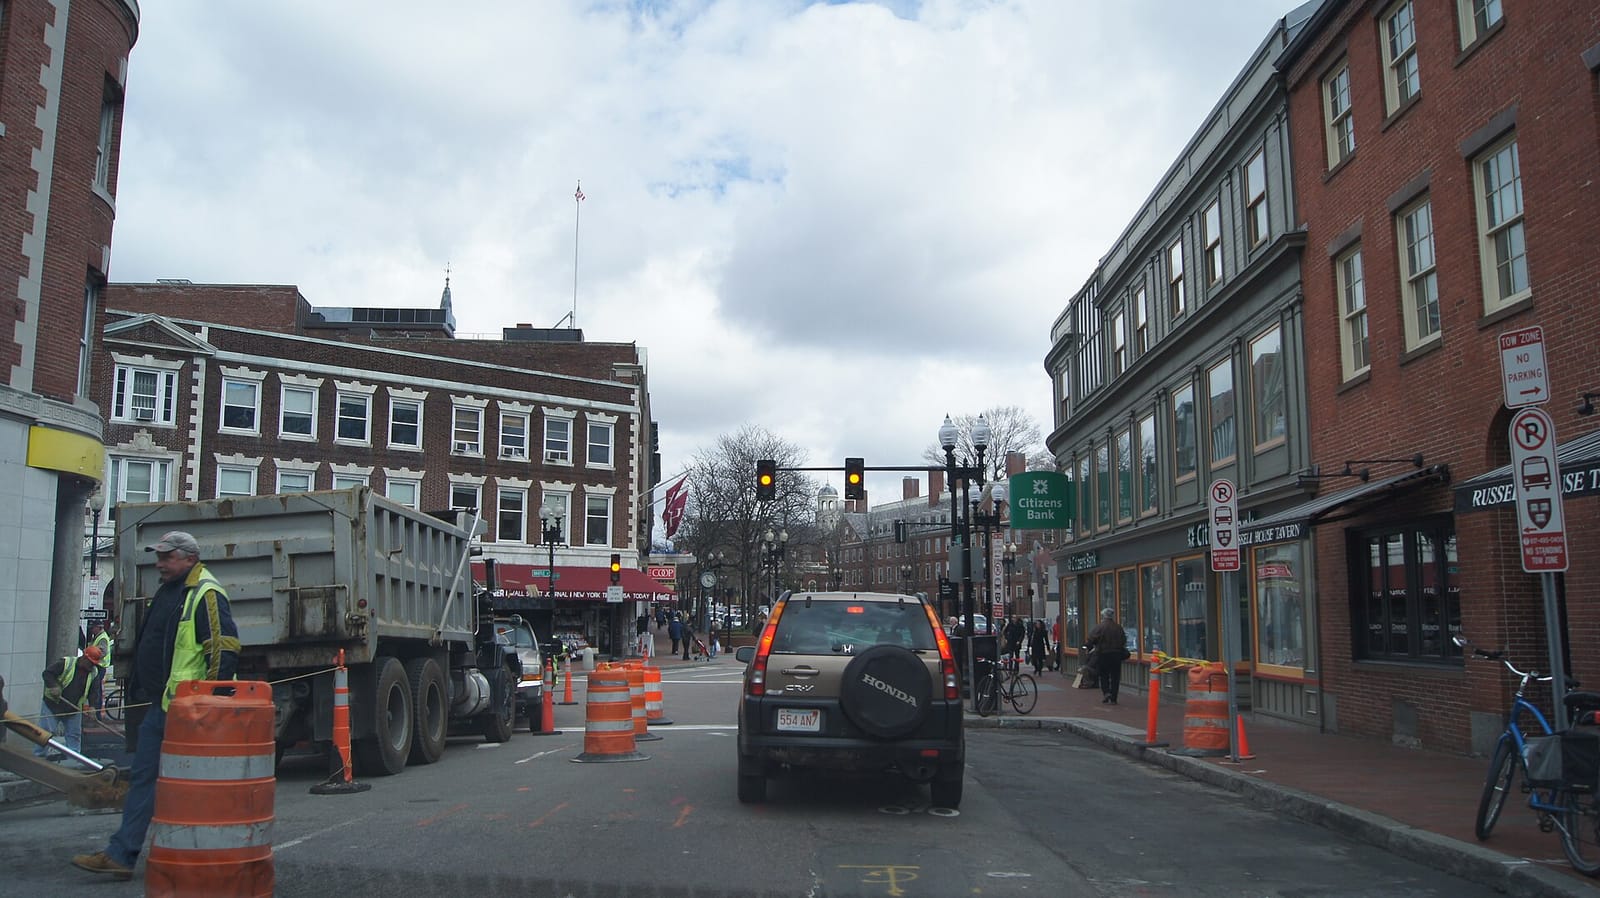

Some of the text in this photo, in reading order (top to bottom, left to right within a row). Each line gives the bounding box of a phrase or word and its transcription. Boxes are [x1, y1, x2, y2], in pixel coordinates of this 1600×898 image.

[1501, 330, 1541, 348] TOW ZONE
[1516, 353, 1530, 364] NO
[1508, 368, 1543, 383] PARKING
[1018, 497, 1062, 508] Citizens
[1027, 509, 1055, 520] Bank
[1275, 523, 1300, 539] TAVERN
[652, 568, 674, 577] COOP
[862, 673, 918, 707] HONDA
[779, 713, 798, 726] 554
